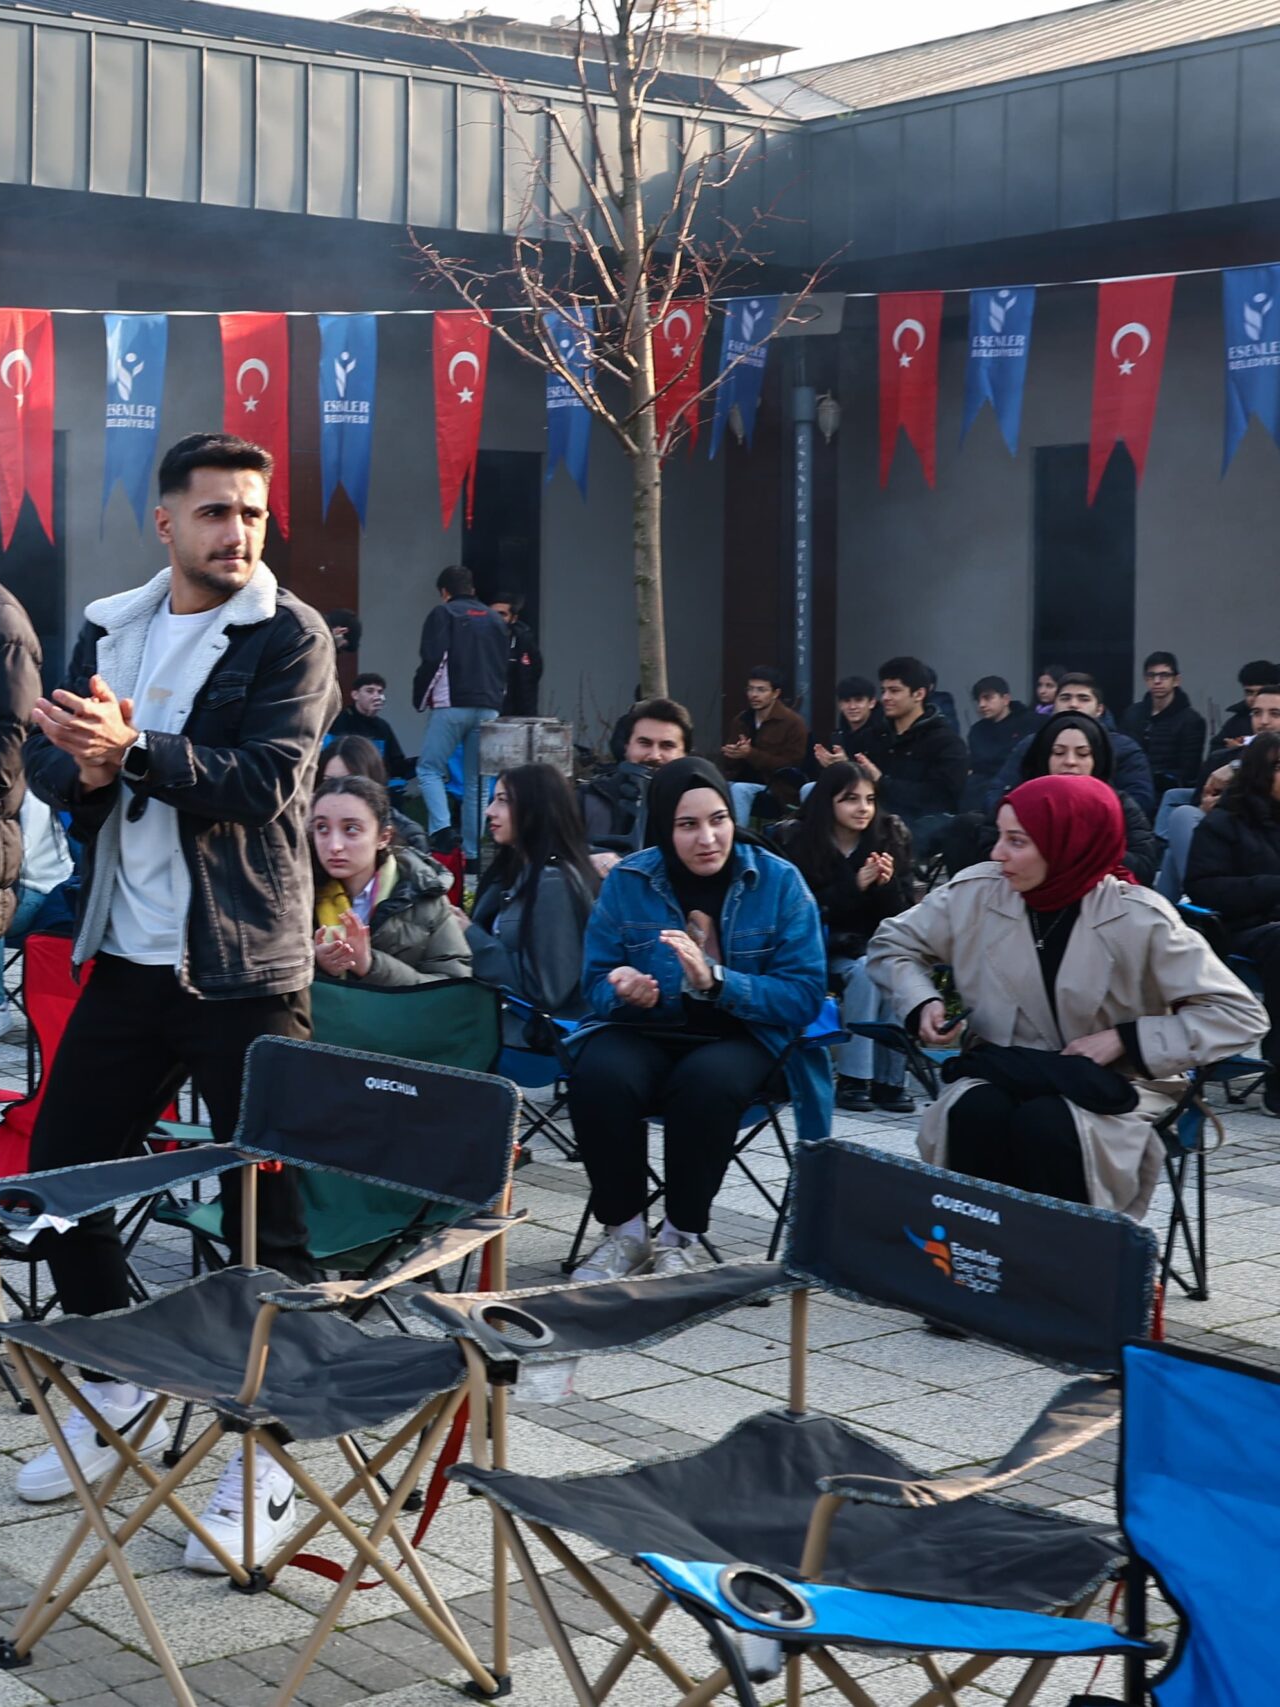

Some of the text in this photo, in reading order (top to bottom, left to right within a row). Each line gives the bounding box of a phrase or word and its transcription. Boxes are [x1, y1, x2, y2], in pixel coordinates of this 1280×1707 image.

[1228, 341, 1280, 360] ESENLE
[106, 403, 156, 418] ESENLER
[365, 1077, 418, 1097] QUECHUA
[931, 1193, 1001, 1225] QUECHUA
